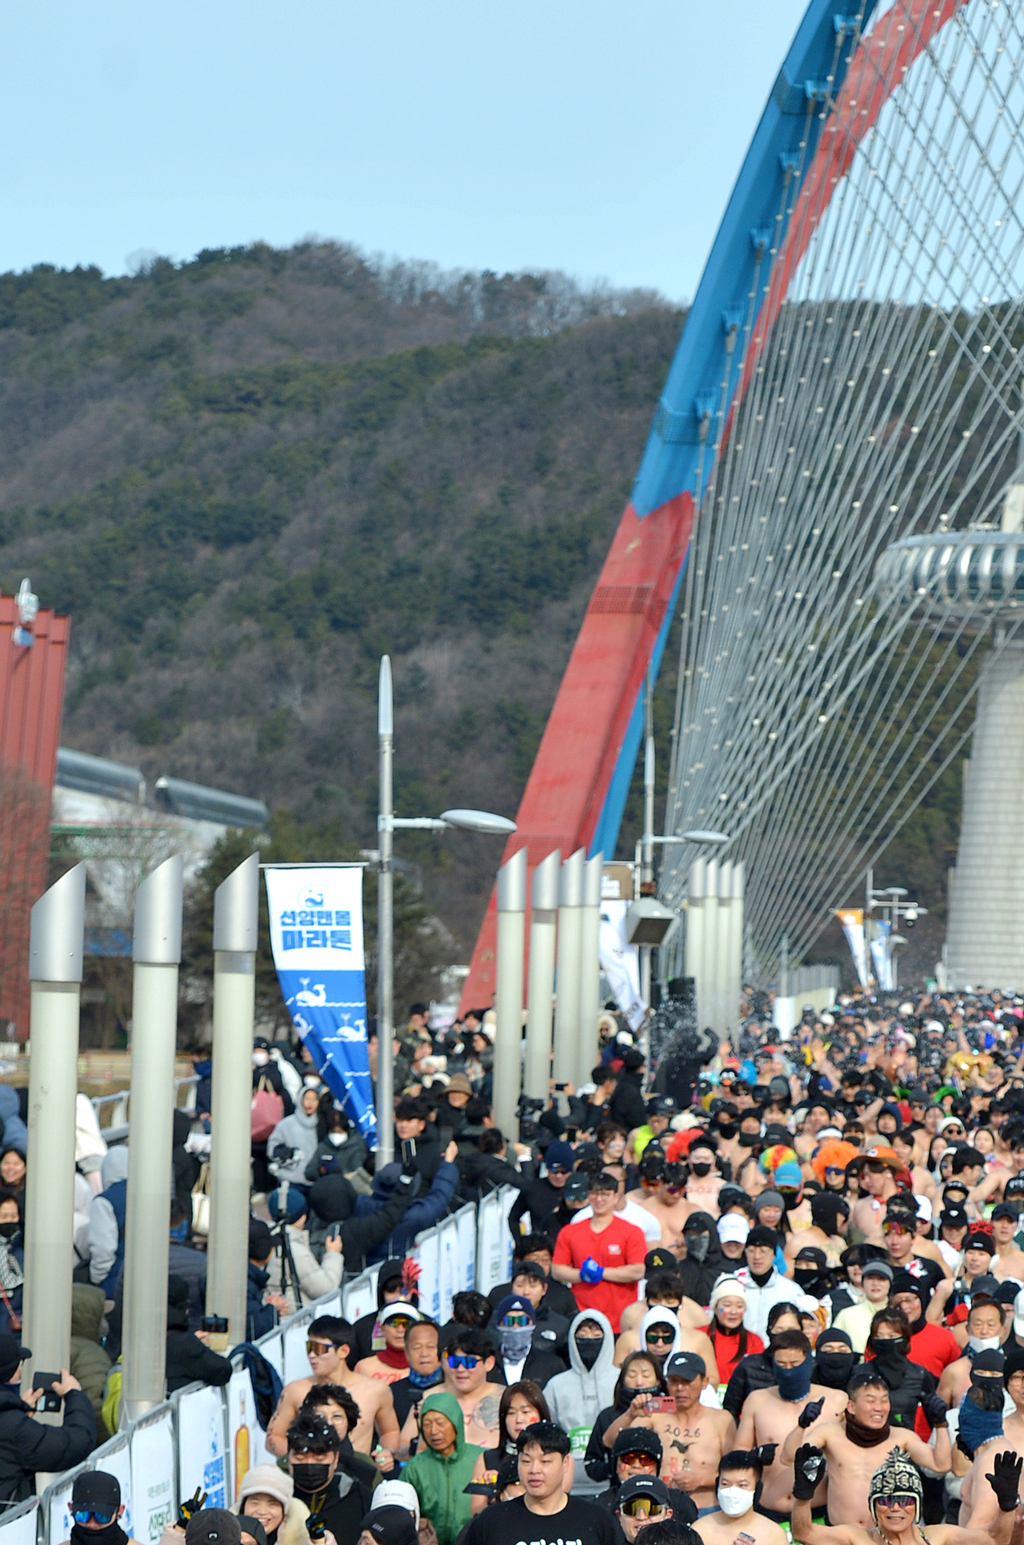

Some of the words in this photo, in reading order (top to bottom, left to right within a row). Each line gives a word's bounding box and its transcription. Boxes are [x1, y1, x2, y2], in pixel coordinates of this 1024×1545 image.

[280, 910, 351, 926] 선양맨몸
[281, 929, 352, 951] 마라톤
[664, 1424, 702, 1438] 2026
